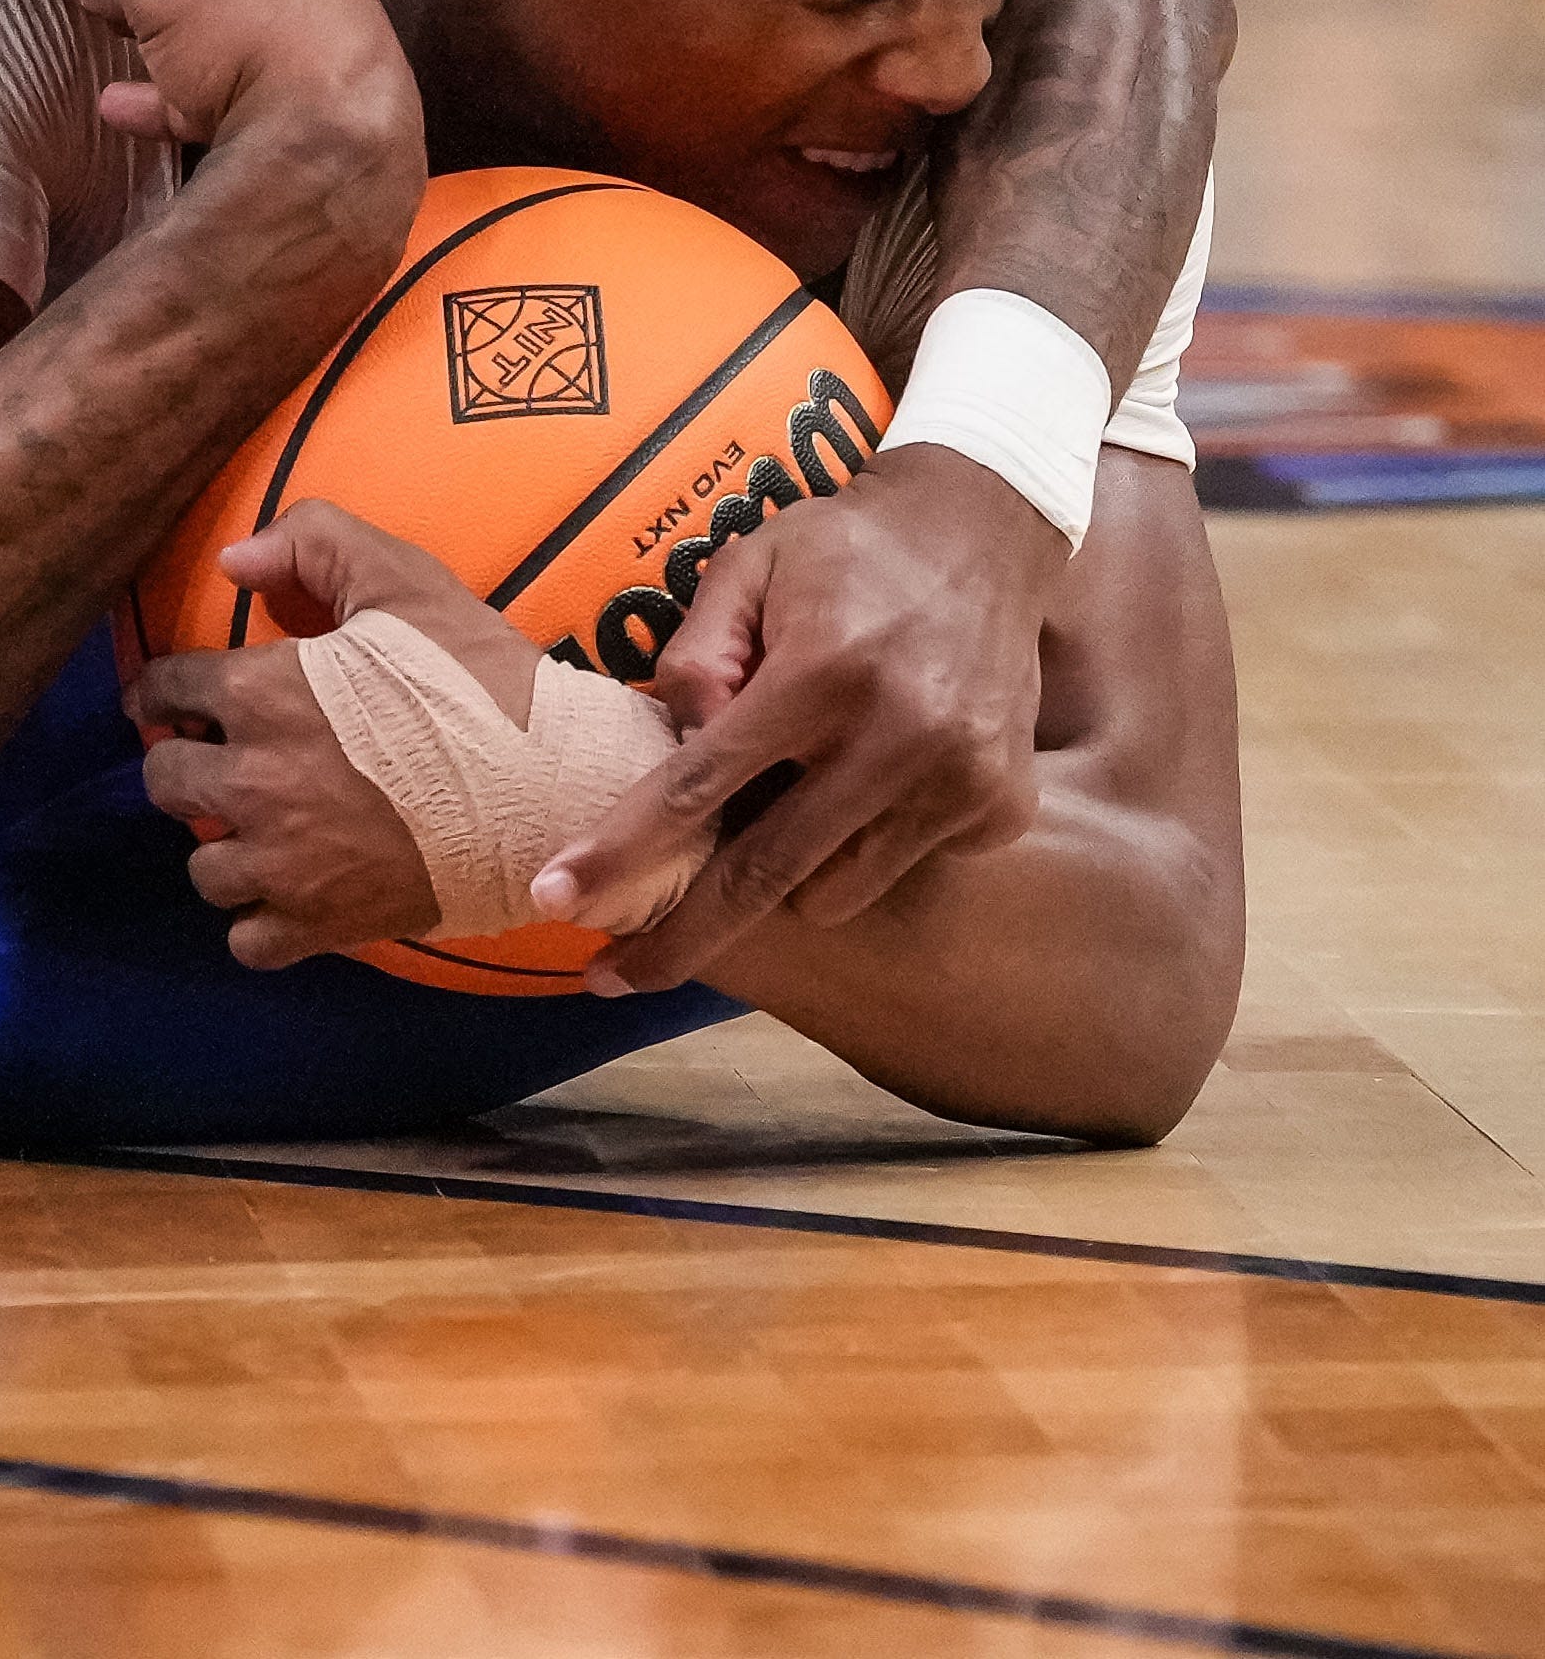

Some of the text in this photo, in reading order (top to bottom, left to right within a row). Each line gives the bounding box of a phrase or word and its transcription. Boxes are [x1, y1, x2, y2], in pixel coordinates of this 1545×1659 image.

[491, 306, 574, 388] NIT
[544, 367, 884, 682] Wso
[631, 440, 746, 559] EVO NXT
